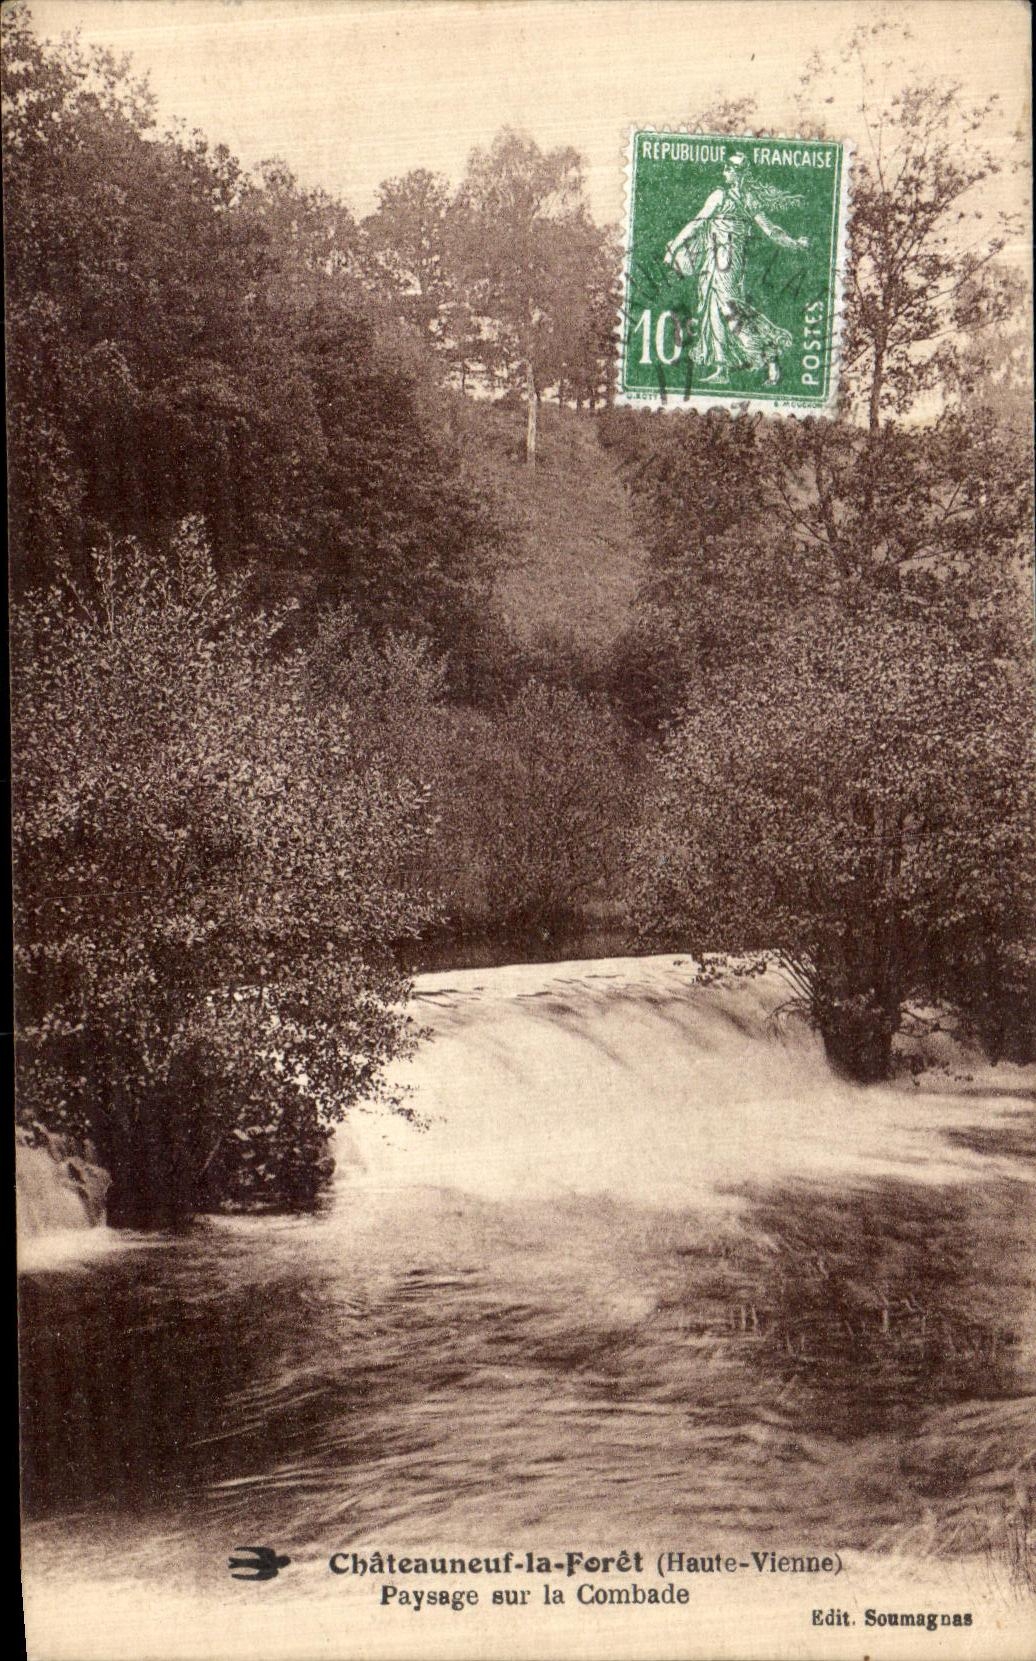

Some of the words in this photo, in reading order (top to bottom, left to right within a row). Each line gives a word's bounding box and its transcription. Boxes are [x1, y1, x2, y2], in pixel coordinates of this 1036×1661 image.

[642, 141, 726, 164] REPUBLIQUE
[753, 148, 832, 168] FRANÇAISE
[801, 301, 824, 386] POSTES
